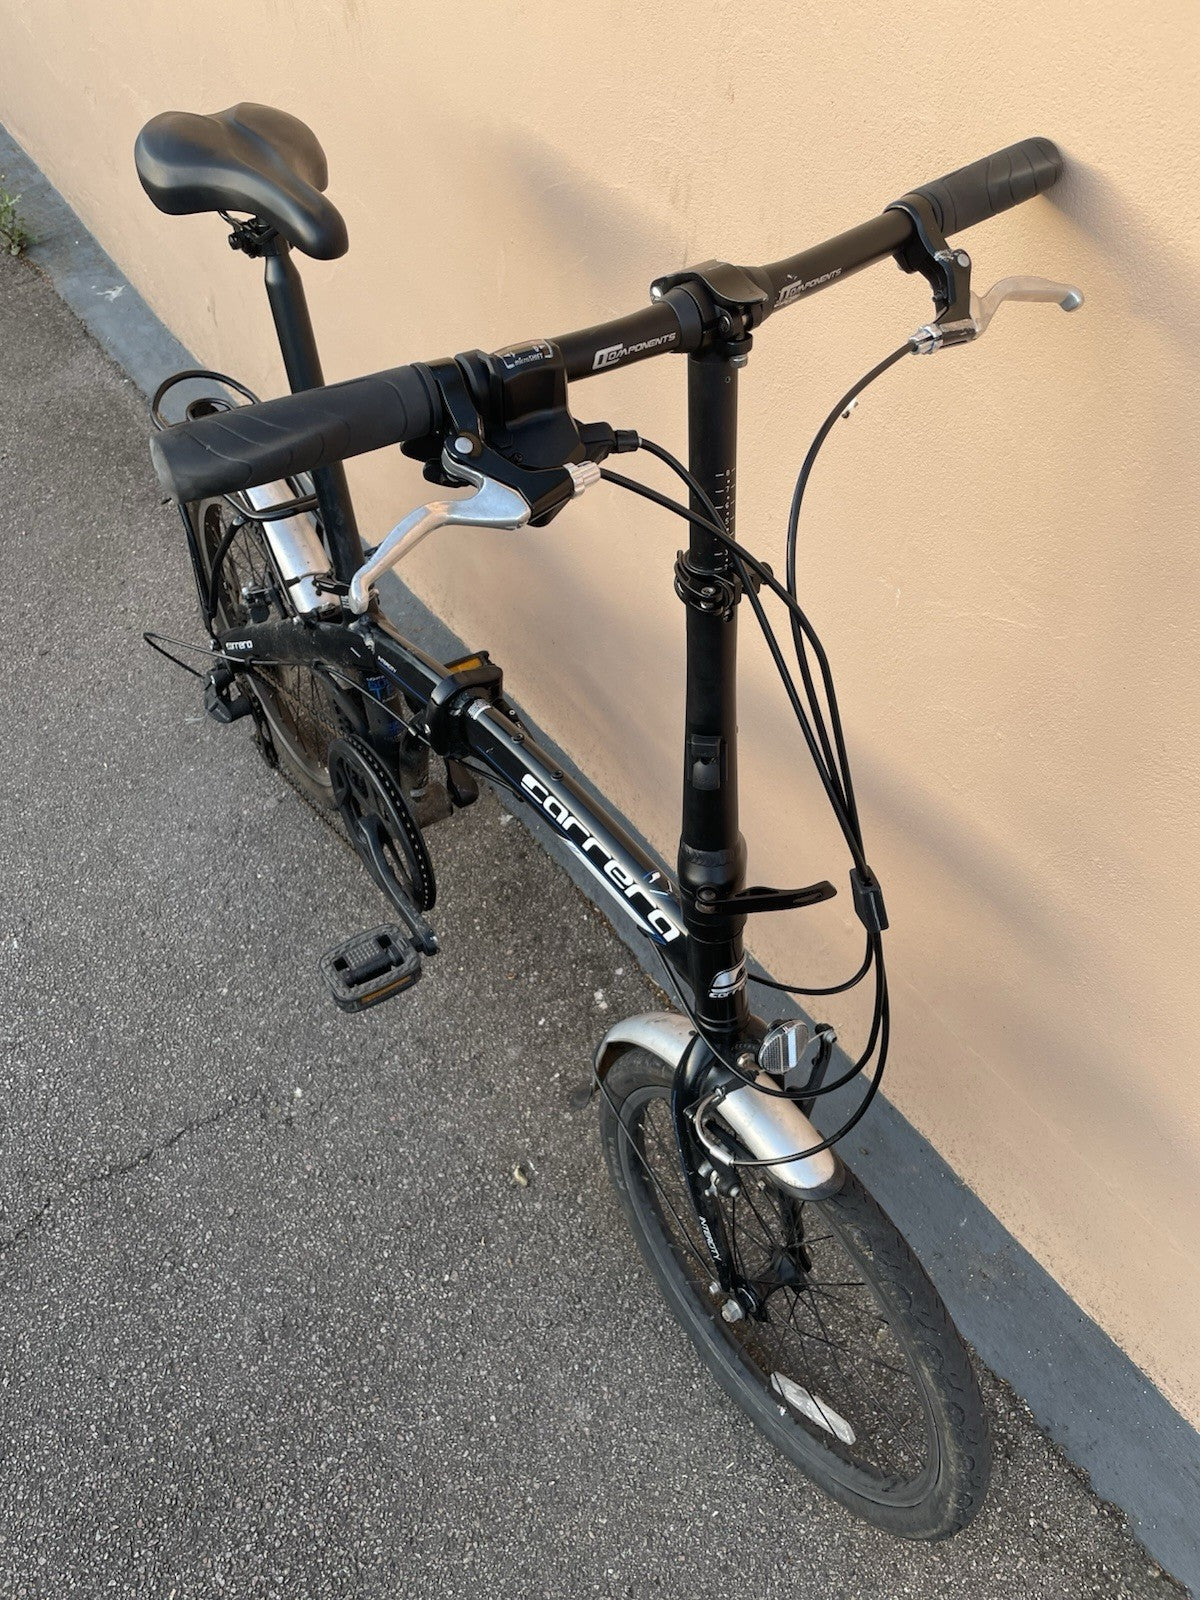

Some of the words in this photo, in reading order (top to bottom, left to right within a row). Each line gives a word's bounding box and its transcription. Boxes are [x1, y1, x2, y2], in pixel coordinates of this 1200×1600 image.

[592, 332, 677, 370] COMPONENTS
[520, 773, 681, 943] carrera
[698, 1215, 723, 1261] INTERCITY
